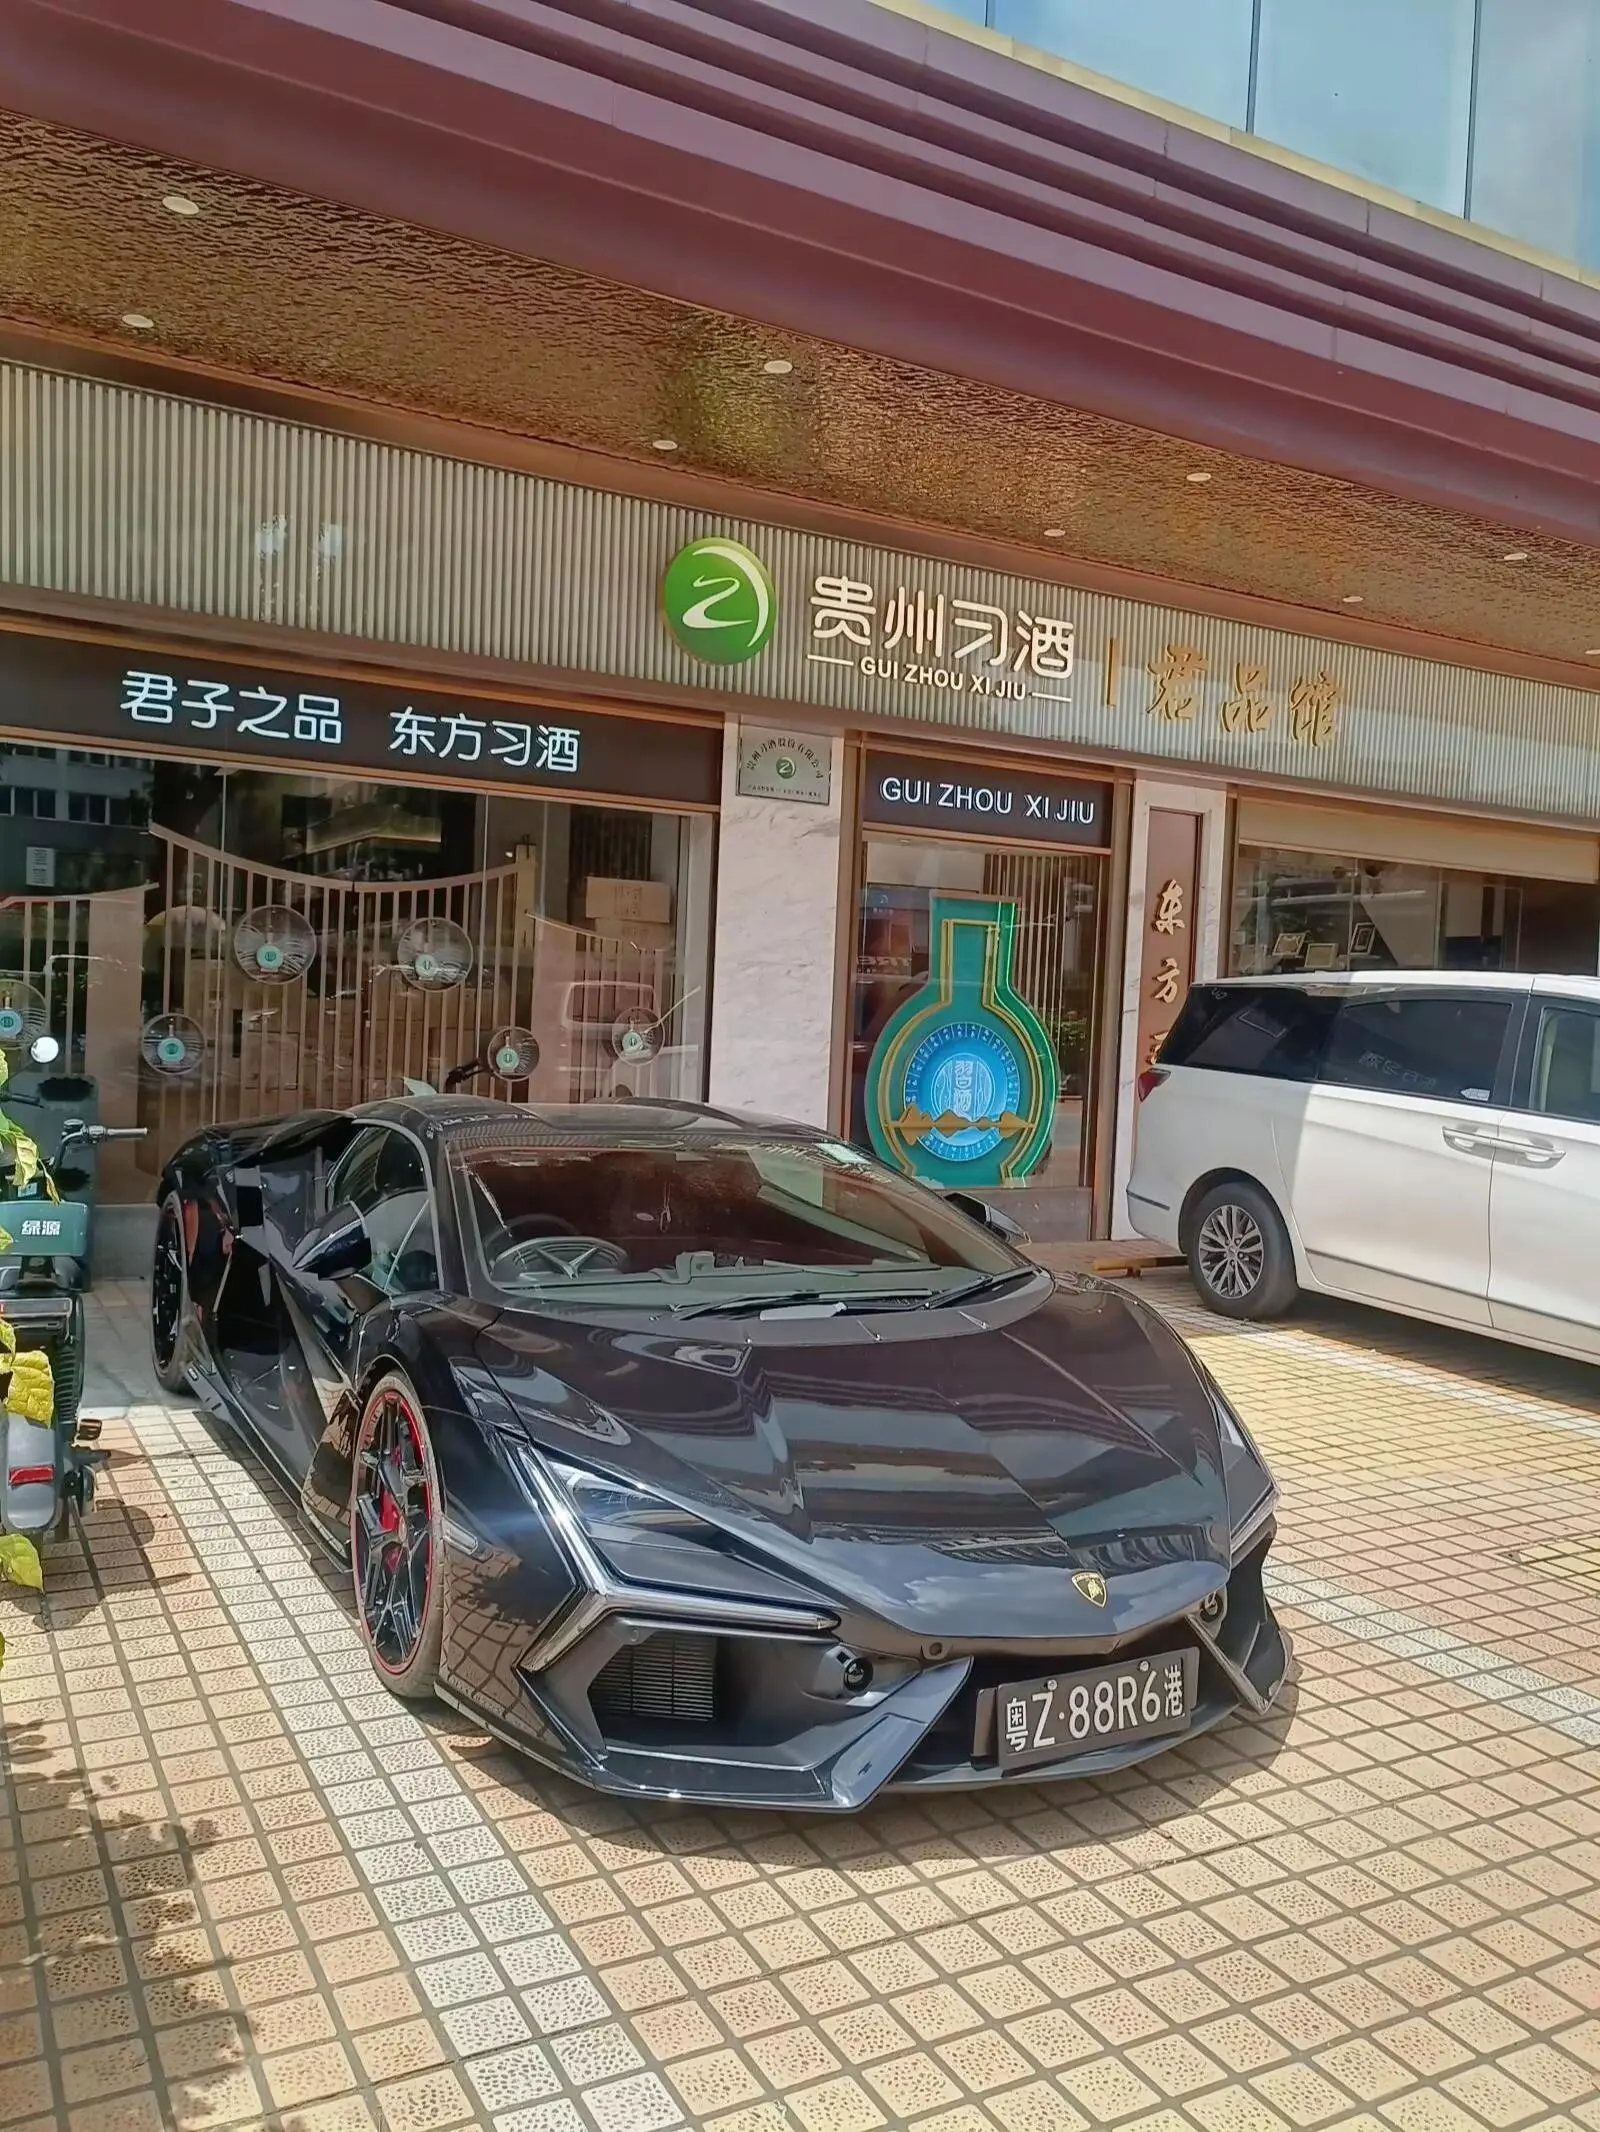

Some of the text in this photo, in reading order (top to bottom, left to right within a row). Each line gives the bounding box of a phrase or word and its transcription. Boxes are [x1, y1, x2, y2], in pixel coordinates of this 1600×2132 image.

[809, 575, 1075, 681] 贵州习酒
[860, 656, 1027, 701] GUI ZHOU XI JIU
[1146, 643, 1344, 746] 君品馆
[120, 670, 580, 773] 君子之品 东方习酒
[880, 777, 1095, 824] GUI ZHOU XI JIU
[21, 1219, 61, 1236] 绿源
